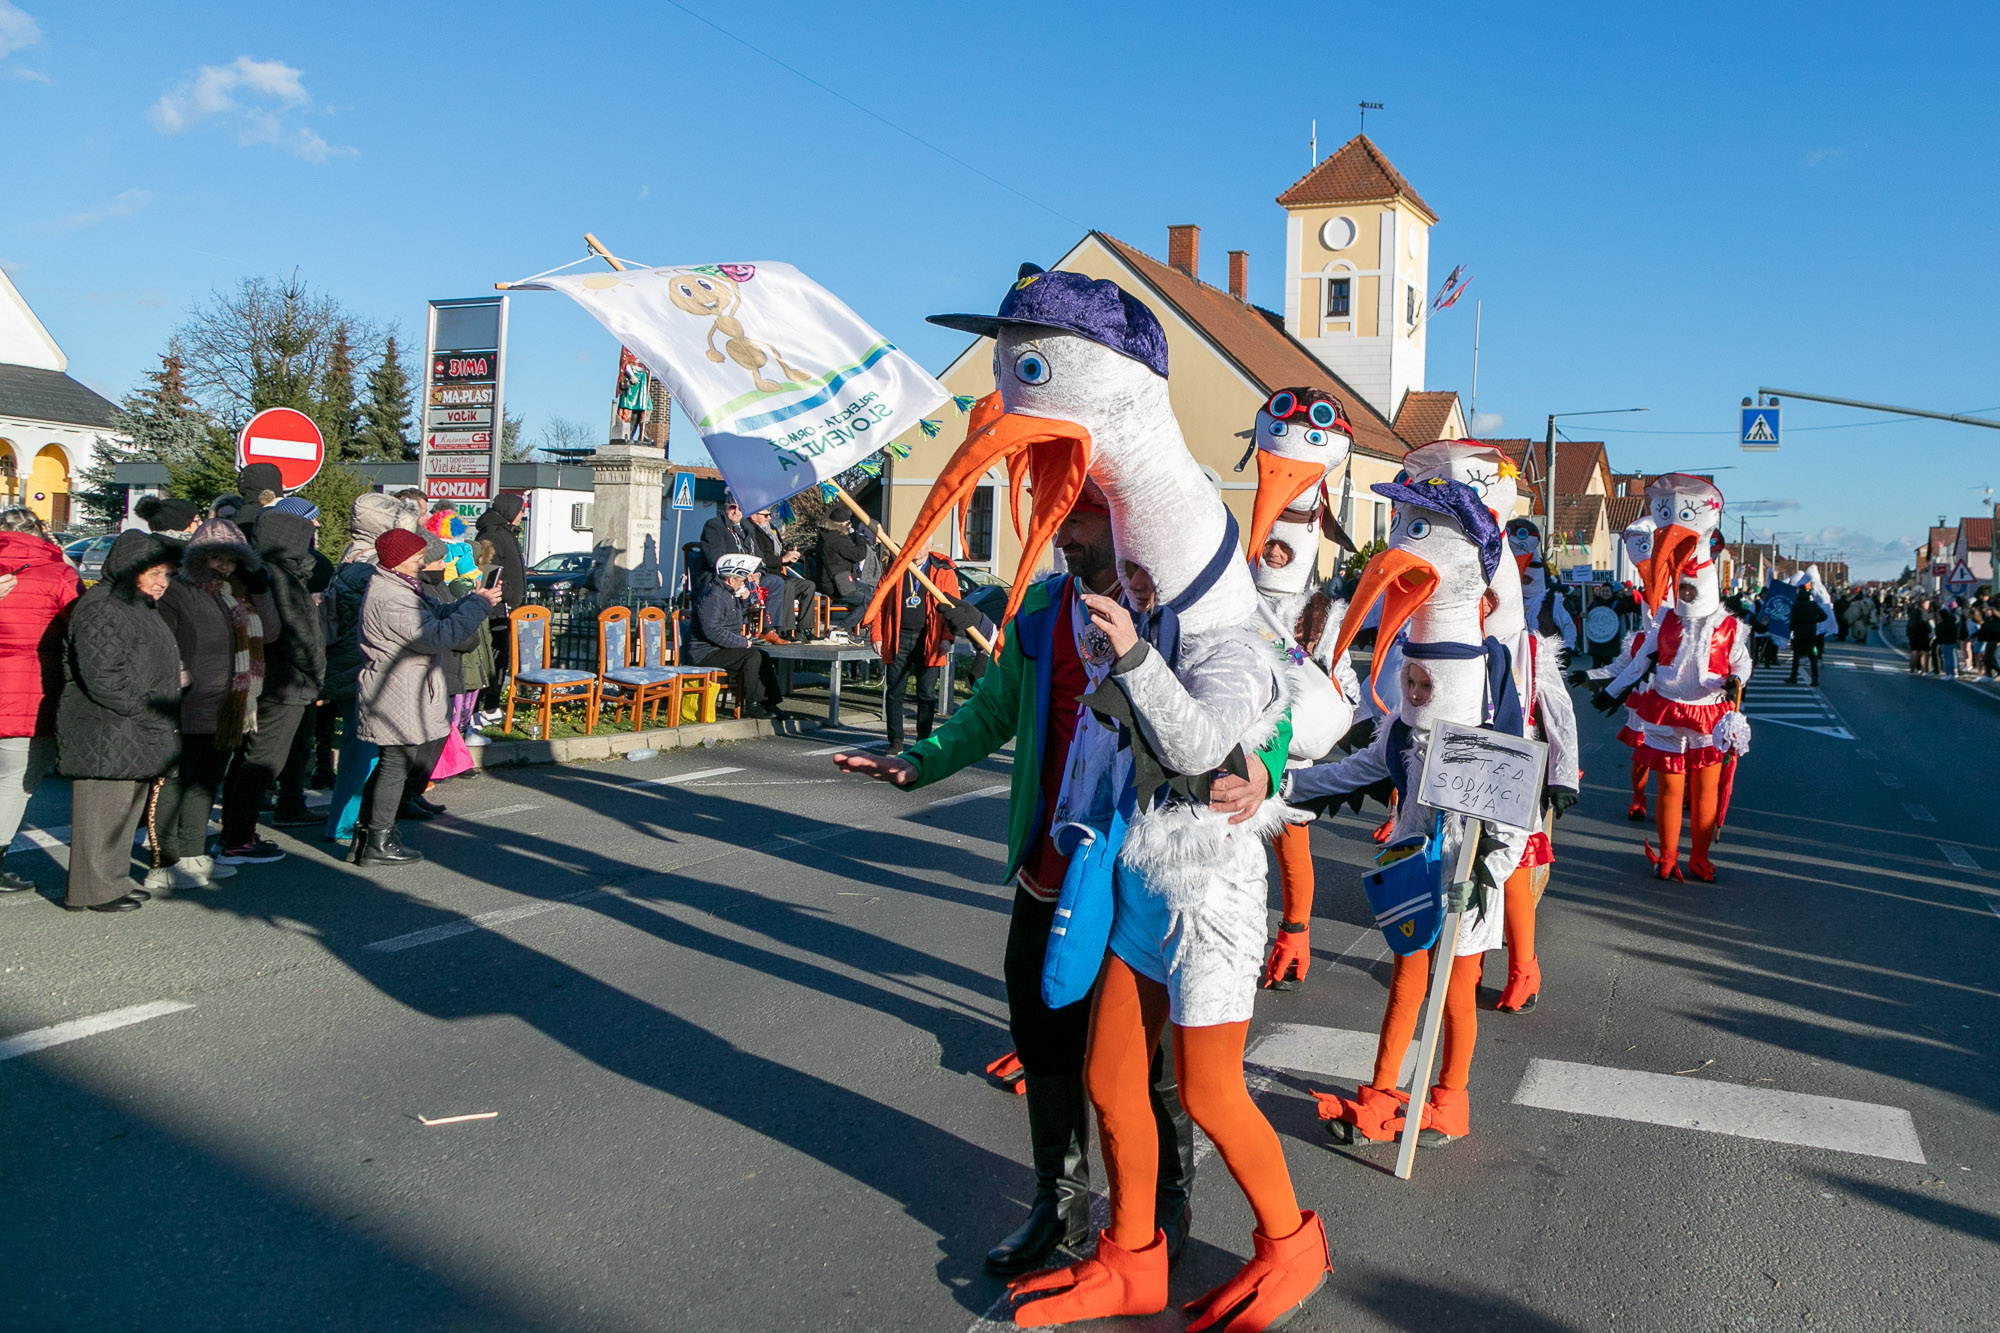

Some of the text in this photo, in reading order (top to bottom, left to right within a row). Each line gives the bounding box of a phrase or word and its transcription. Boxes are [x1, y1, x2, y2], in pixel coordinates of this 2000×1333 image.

[449, 358, 487, 376] BIMA
[430, 481, 486, 497] KONZUM
[1433, 772, 1521, 804] SODINCI
